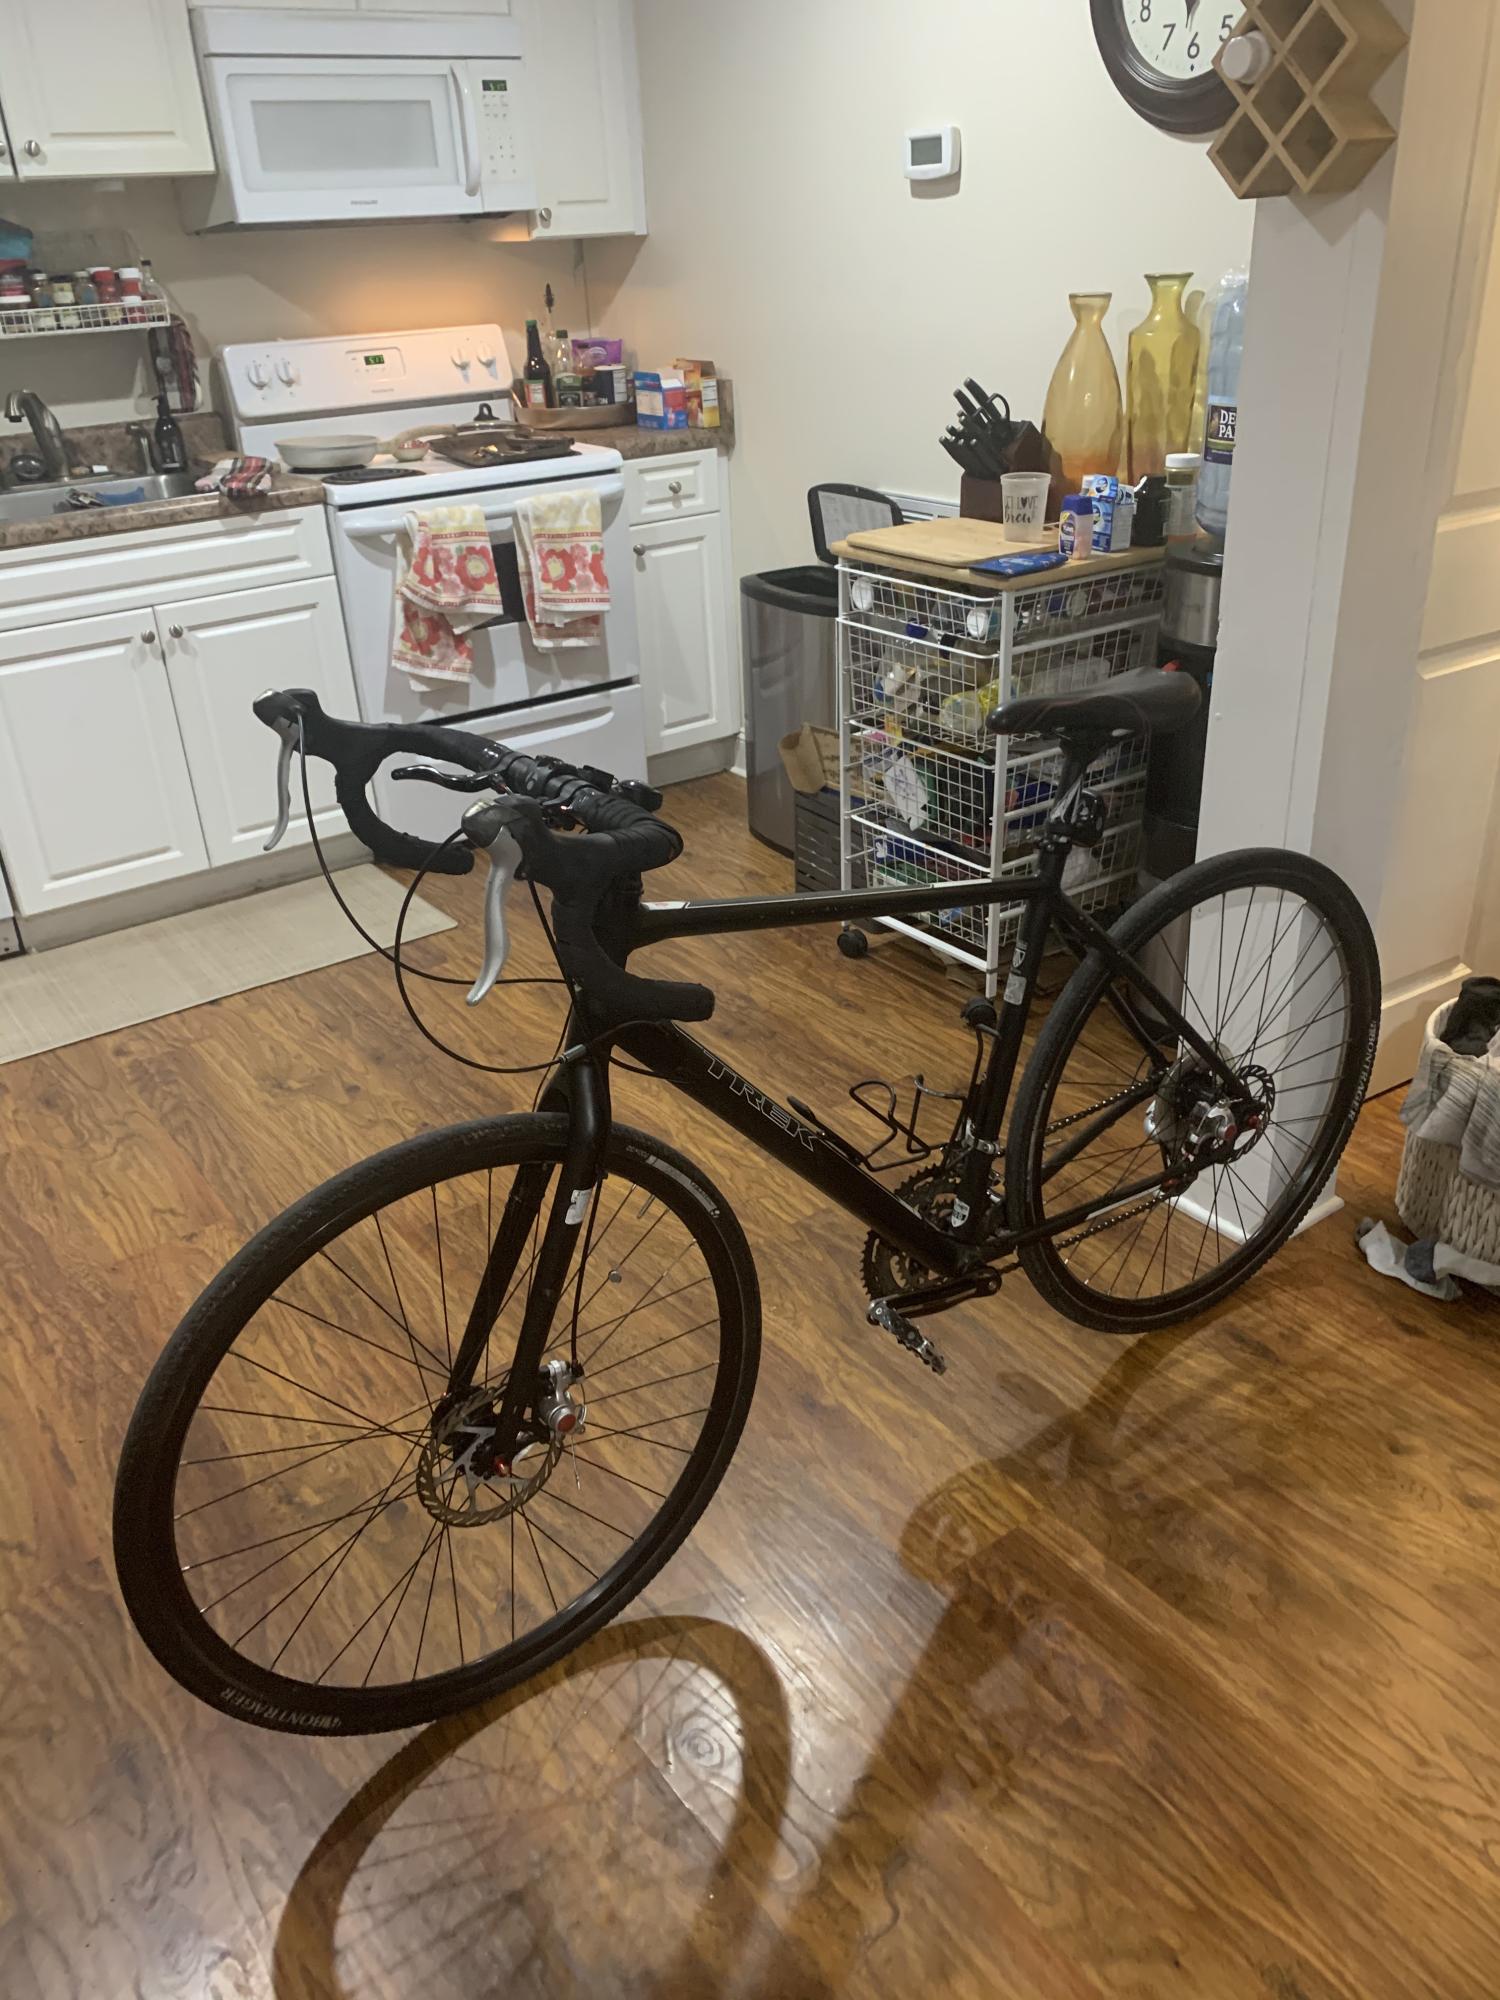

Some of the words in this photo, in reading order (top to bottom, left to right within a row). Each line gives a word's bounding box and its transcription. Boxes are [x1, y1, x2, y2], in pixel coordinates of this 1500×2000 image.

[1163, 23, 1176, 51] 7
[1218, 14, 1234, 42] 5
[1187, 32, 1200, 59] 6
[703, 1048, 818, 1152] TREK
